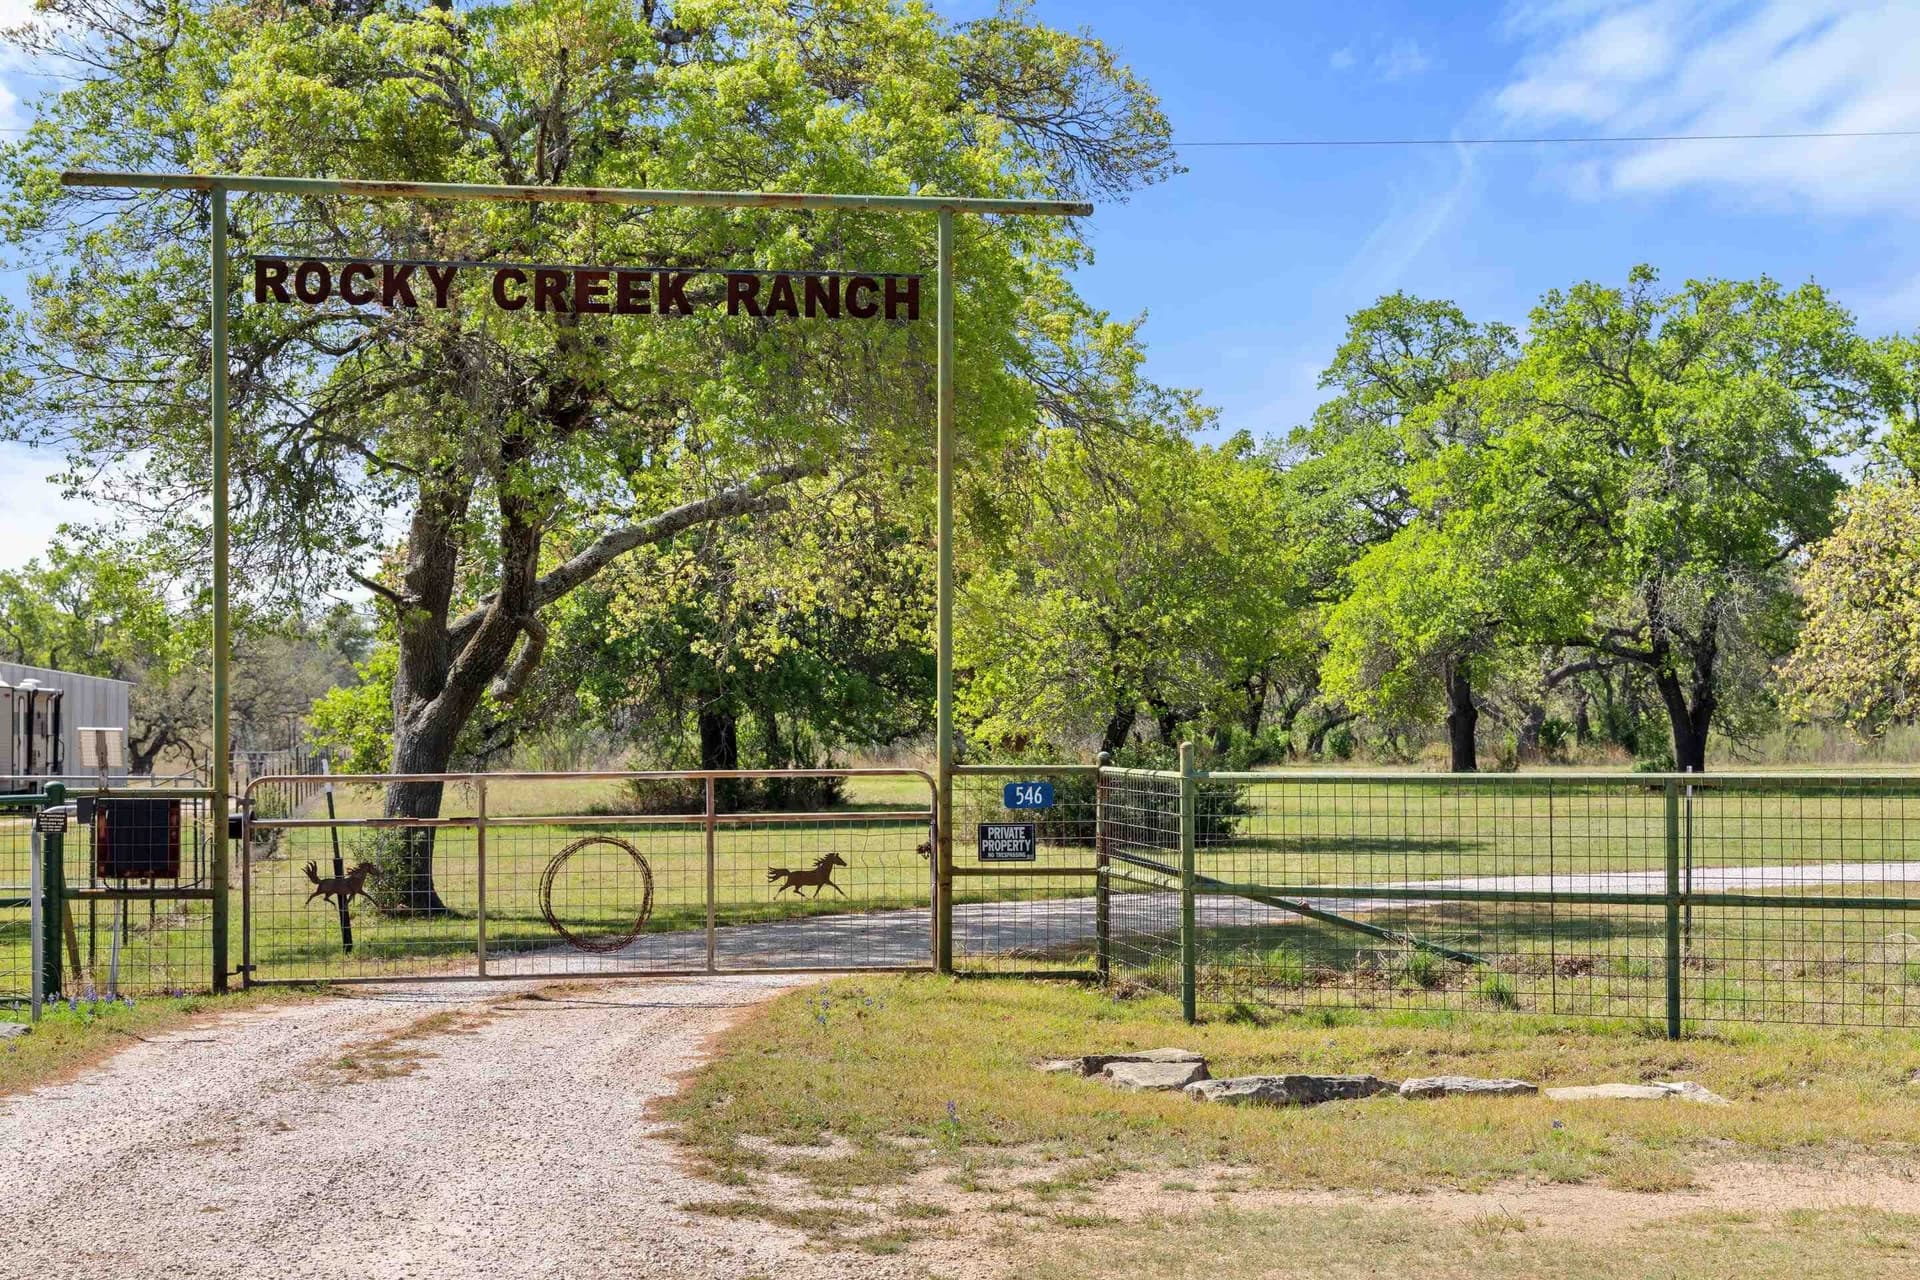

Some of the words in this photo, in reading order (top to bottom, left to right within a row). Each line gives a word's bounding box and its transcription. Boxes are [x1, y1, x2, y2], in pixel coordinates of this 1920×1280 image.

[255, 260, 457, 308] ROCKY
[493, 268, 693, 315] CREEK
[727, 274, 920, 321] RANCH
[1016, 786, 1043, 805] 546
[988, 827, 1026, 839] PRIVATE
[982, 840, 1031, 851] PROPERTY
